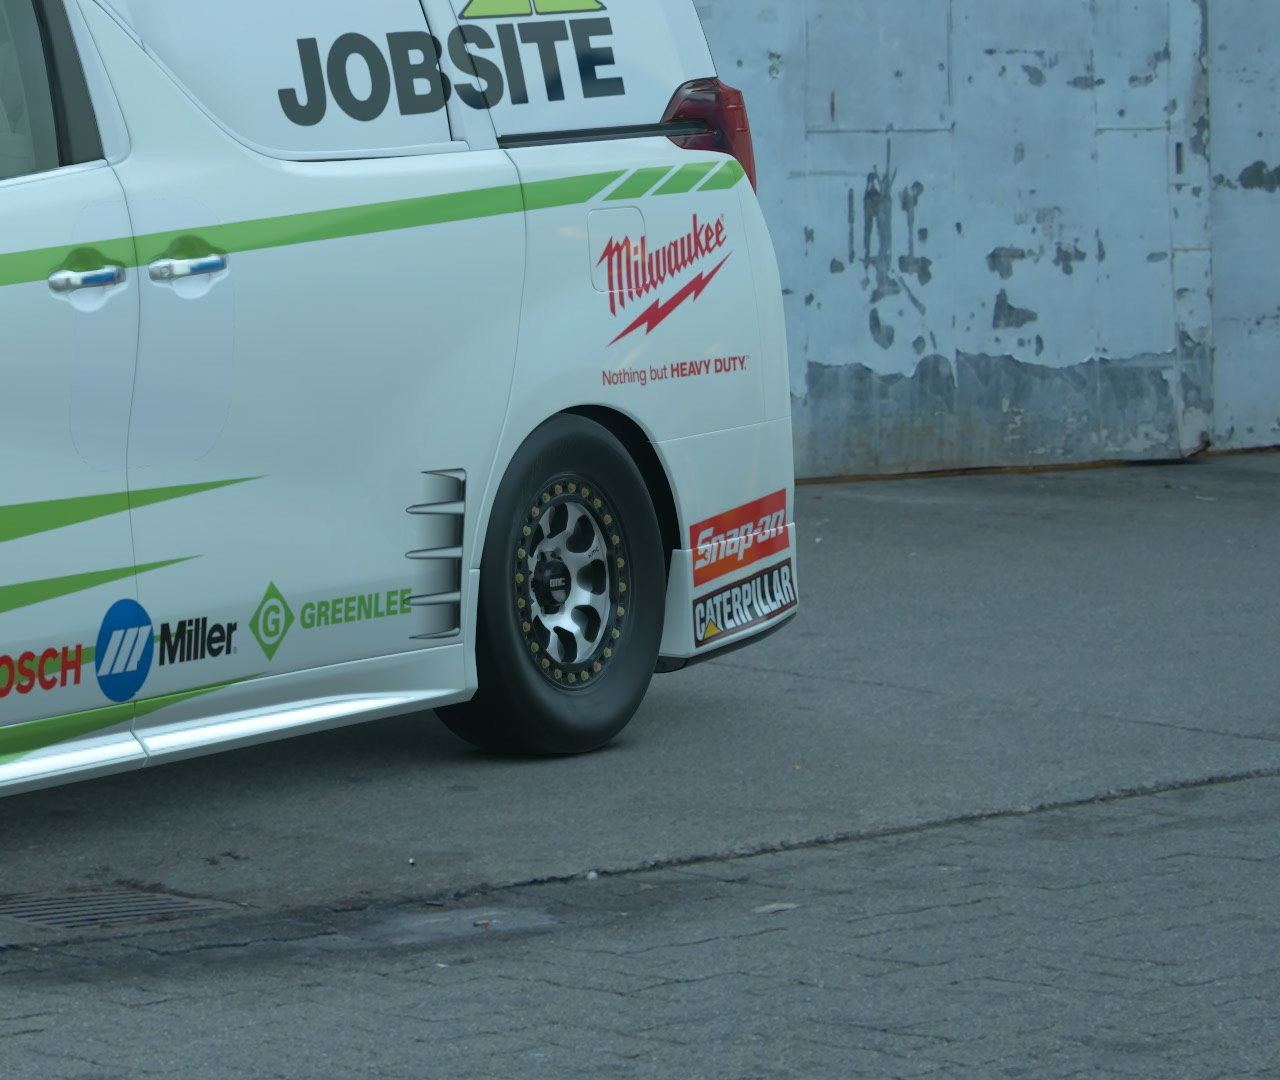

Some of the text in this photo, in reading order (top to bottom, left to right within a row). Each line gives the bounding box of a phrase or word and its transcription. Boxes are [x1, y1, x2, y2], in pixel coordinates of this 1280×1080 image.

[277, 17, 625, 126] JOBSITE
[596, 213, 727, 318] Milwaukee
[602, 366, 647, 386] Nothing
[650, 365, 668, 381] but
[670, 359, 711, 379] HEAVY
[694, 508, 785, 570] Snap-on
[300, 588, 413, 630] GREENLEE
[695, 565, 794, 641] CATERPILLAR
[158, 617, 238, 666] Miller
